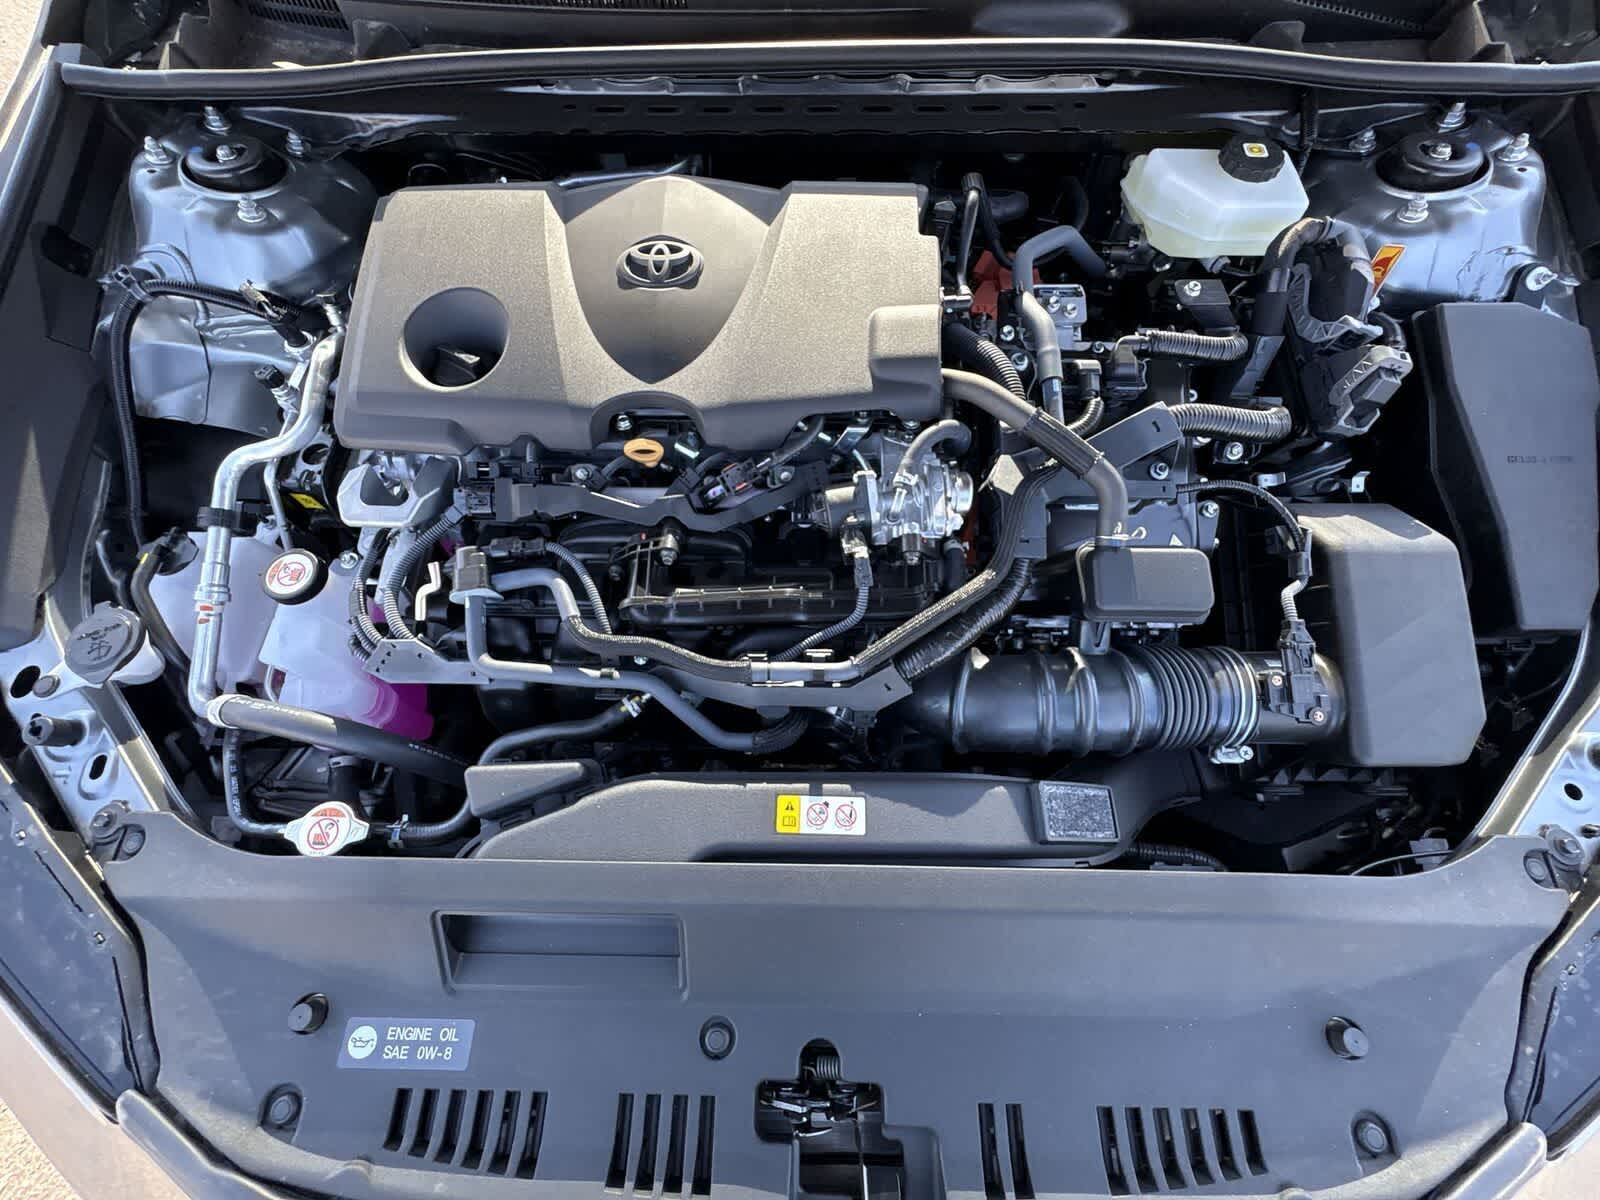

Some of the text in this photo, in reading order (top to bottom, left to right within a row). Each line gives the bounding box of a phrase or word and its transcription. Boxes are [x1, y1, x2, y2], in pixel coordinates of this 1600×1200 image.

[386, 1026, 460, 1042] ENGINE OIL
[382, 1045, 453, 1061] SAE 0W-8
